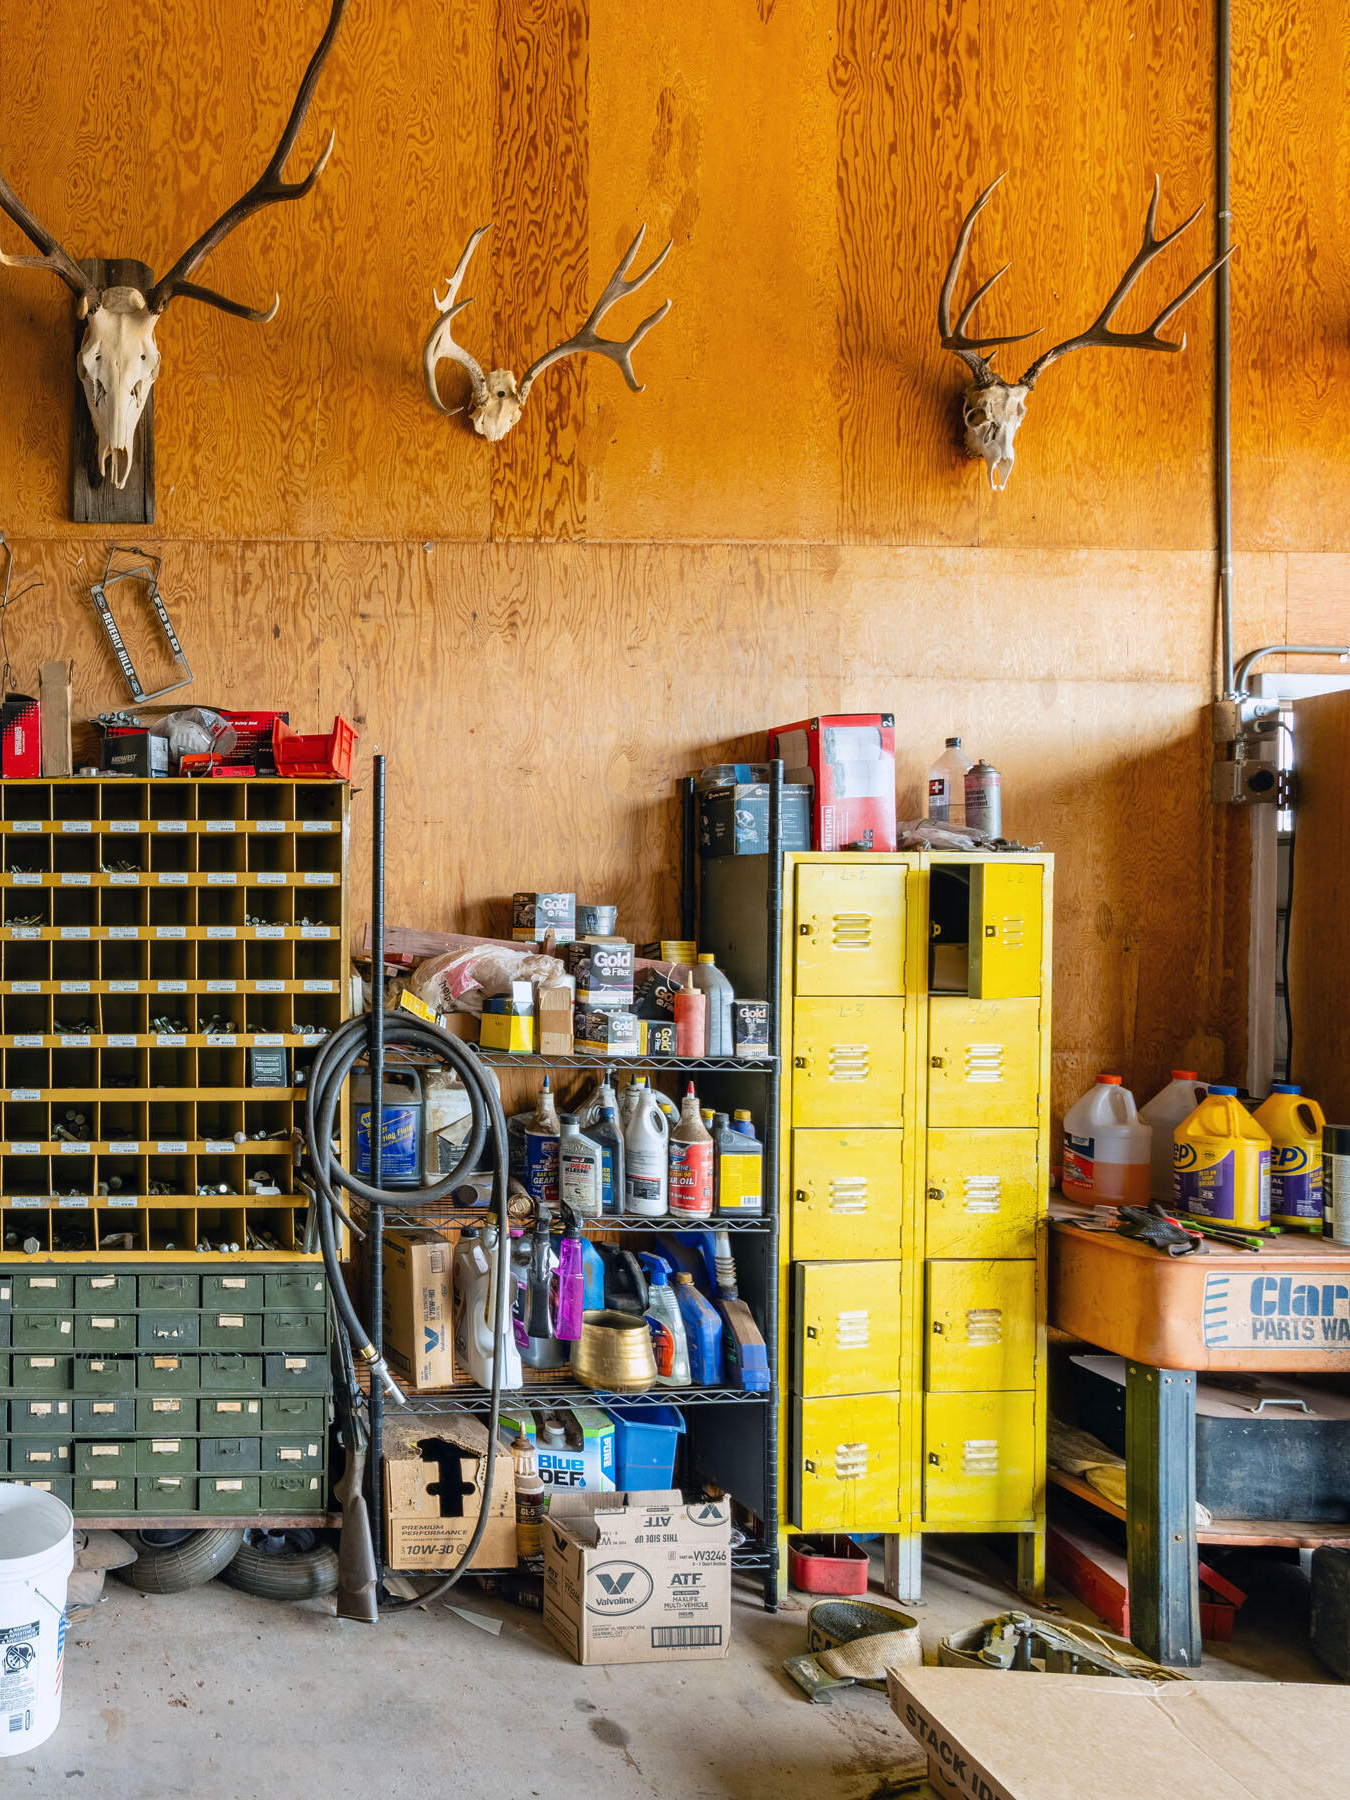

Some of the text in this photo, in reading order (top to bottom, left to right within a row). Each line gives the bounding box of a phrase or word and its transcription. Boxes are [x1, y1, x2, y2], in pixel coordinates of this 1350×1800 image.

[153, 596, 180, 651] FORD
[102, 612, 135, 676] BEVERLY HILLS
[110, 753, 138, 763] MIDWEST
[542, 898, 569, 910] Gold
[593, 951, 631, 968] Gold
[611, 968, 630, 977] Filter
[654, 986, 675, 1003] Go
[739, 1007, 768, 1019] Gold
[612, 1021, 634, 1031] Gold
[660, 1027, 672, 1051] Gold
[1173, 1143, 1190, 1163] ep
[1271, 1146, 1299, 1166] ep
[532, 1177, 555, 1185] GEAR
[679, 1177, 695, 1185] OIL
[1251, 1318, 1315, 1341] PARTS
[602, 1436, 613, 1468] PURE
[537, 1454, 585, 1471] Blue
[538, 1468, 584, 1486] DEF
[644, 1516, 671, 1528] ATF
[634, 1534, 644, 1543] UP
[646, 1534, 661, 1543] SIDE
[662, 1534, 678, 1543] THIS
[406, 1543, 454, 1555] 10W-30
[693, 1550, 727, 1561] VV3246
[670, 1572, 703, 1586] ATF
[595, 1597, 635, 1606] Valvoline
[905, 1703, 968, 1784] STACK
